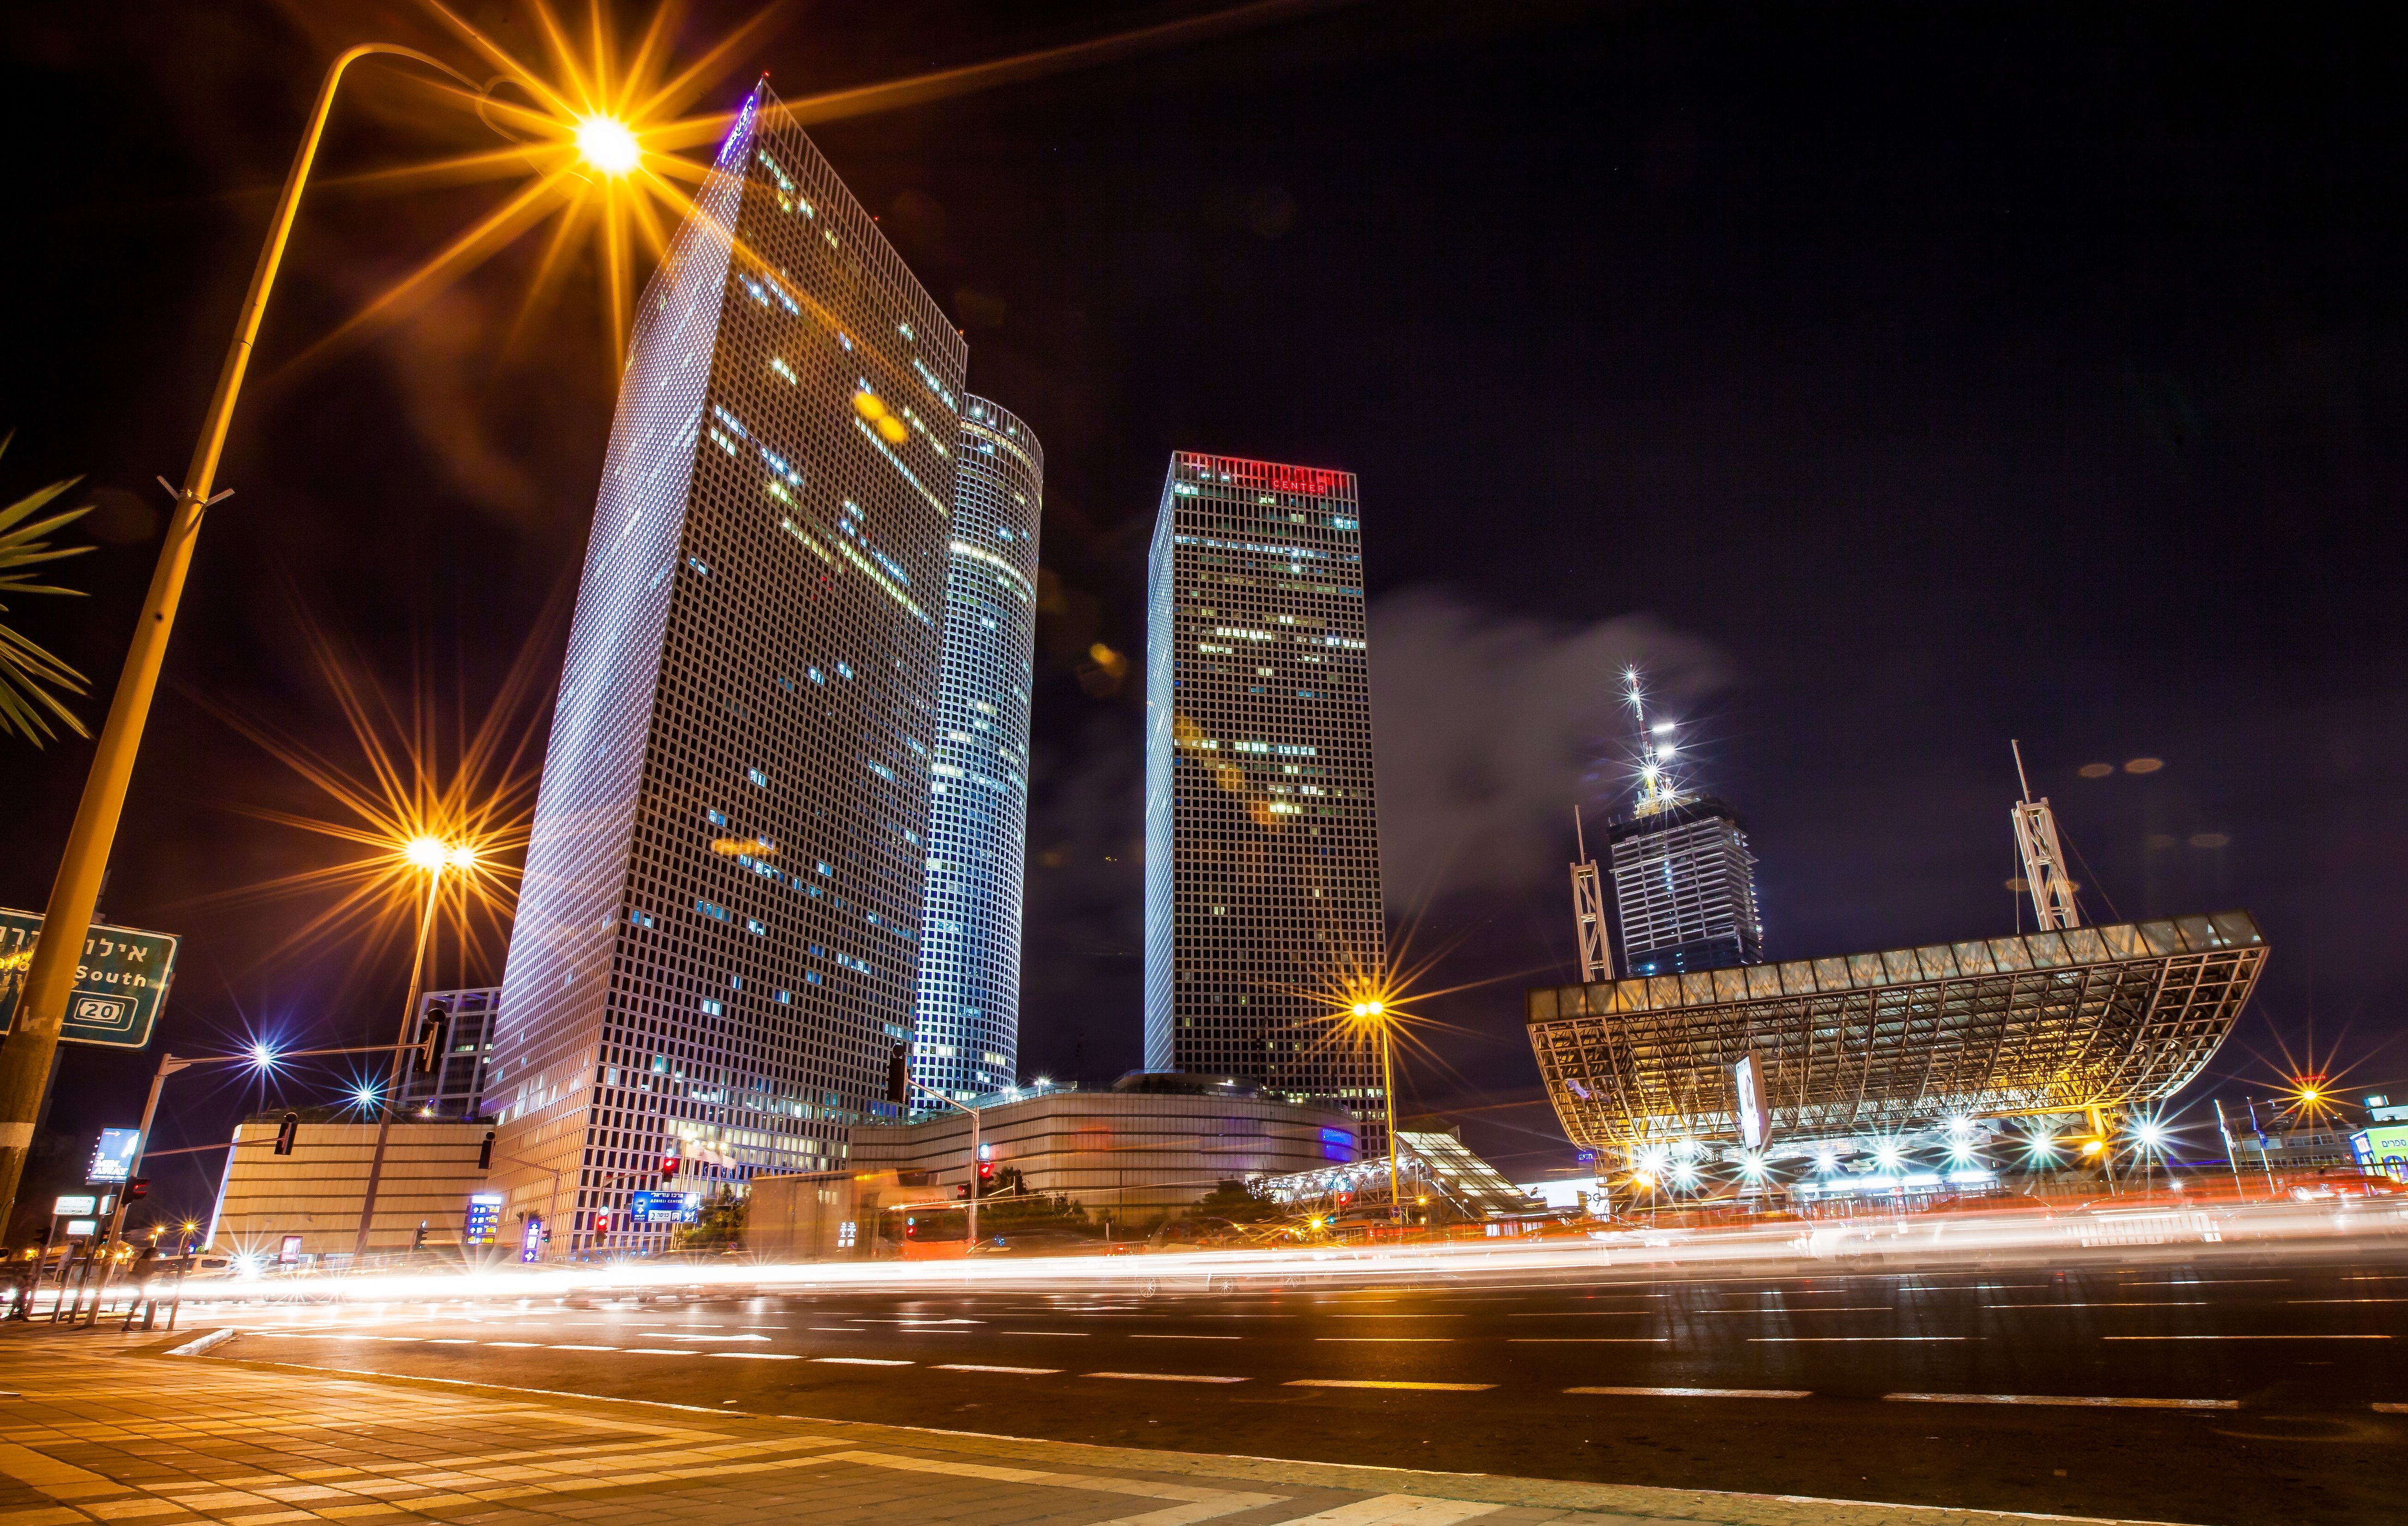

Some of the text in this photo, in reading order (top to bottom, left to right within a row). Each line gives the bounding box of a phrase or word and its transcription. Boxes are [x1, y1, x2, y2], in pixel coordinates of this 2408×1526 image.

[1273, 480, 1325, 493] CENTER
[86, 938, 149, 963] אילו
[74, 965, 147, 987] South
[85, 1003, 114, 1018] 20
[2381, 1139, 2407, 1147] ספרים
[1794, 1165, 1831, 1174] HASHALOM
